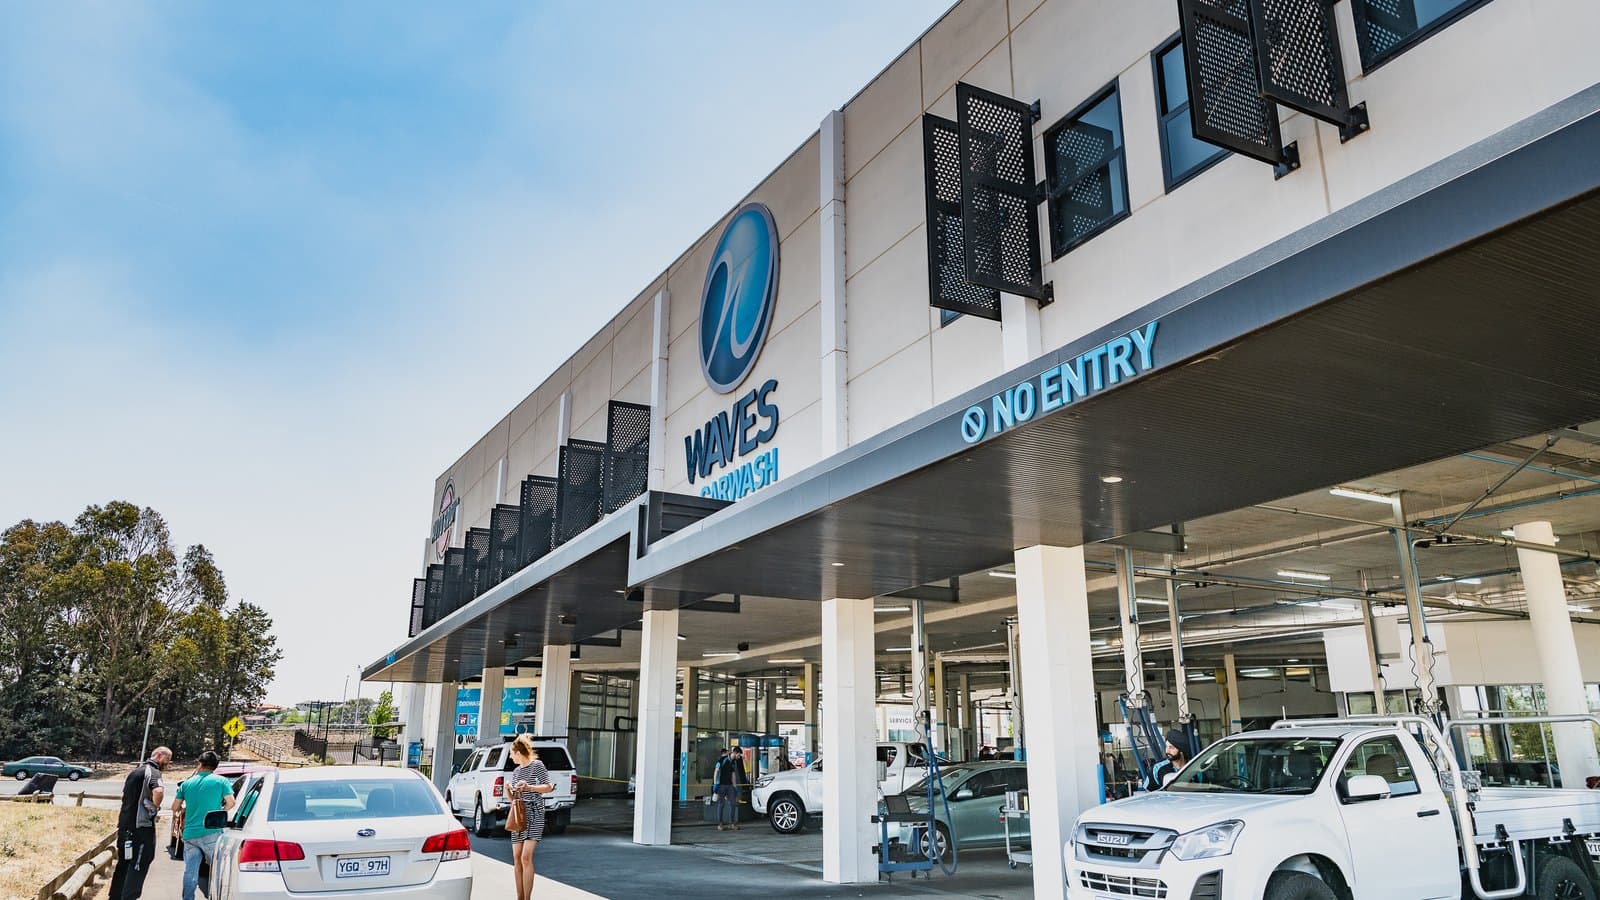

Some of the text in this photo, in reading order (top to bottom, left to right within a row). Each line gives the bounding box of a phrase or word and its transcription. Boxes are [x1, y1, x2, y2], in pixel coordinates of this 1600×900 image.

[992, 320, 1159, 433] NO ENTRY
[684, 379, 779, 484] WAVES
[367, 860, 388, 871] 97H
[1097, 832, 1128, 845] ISUZU
